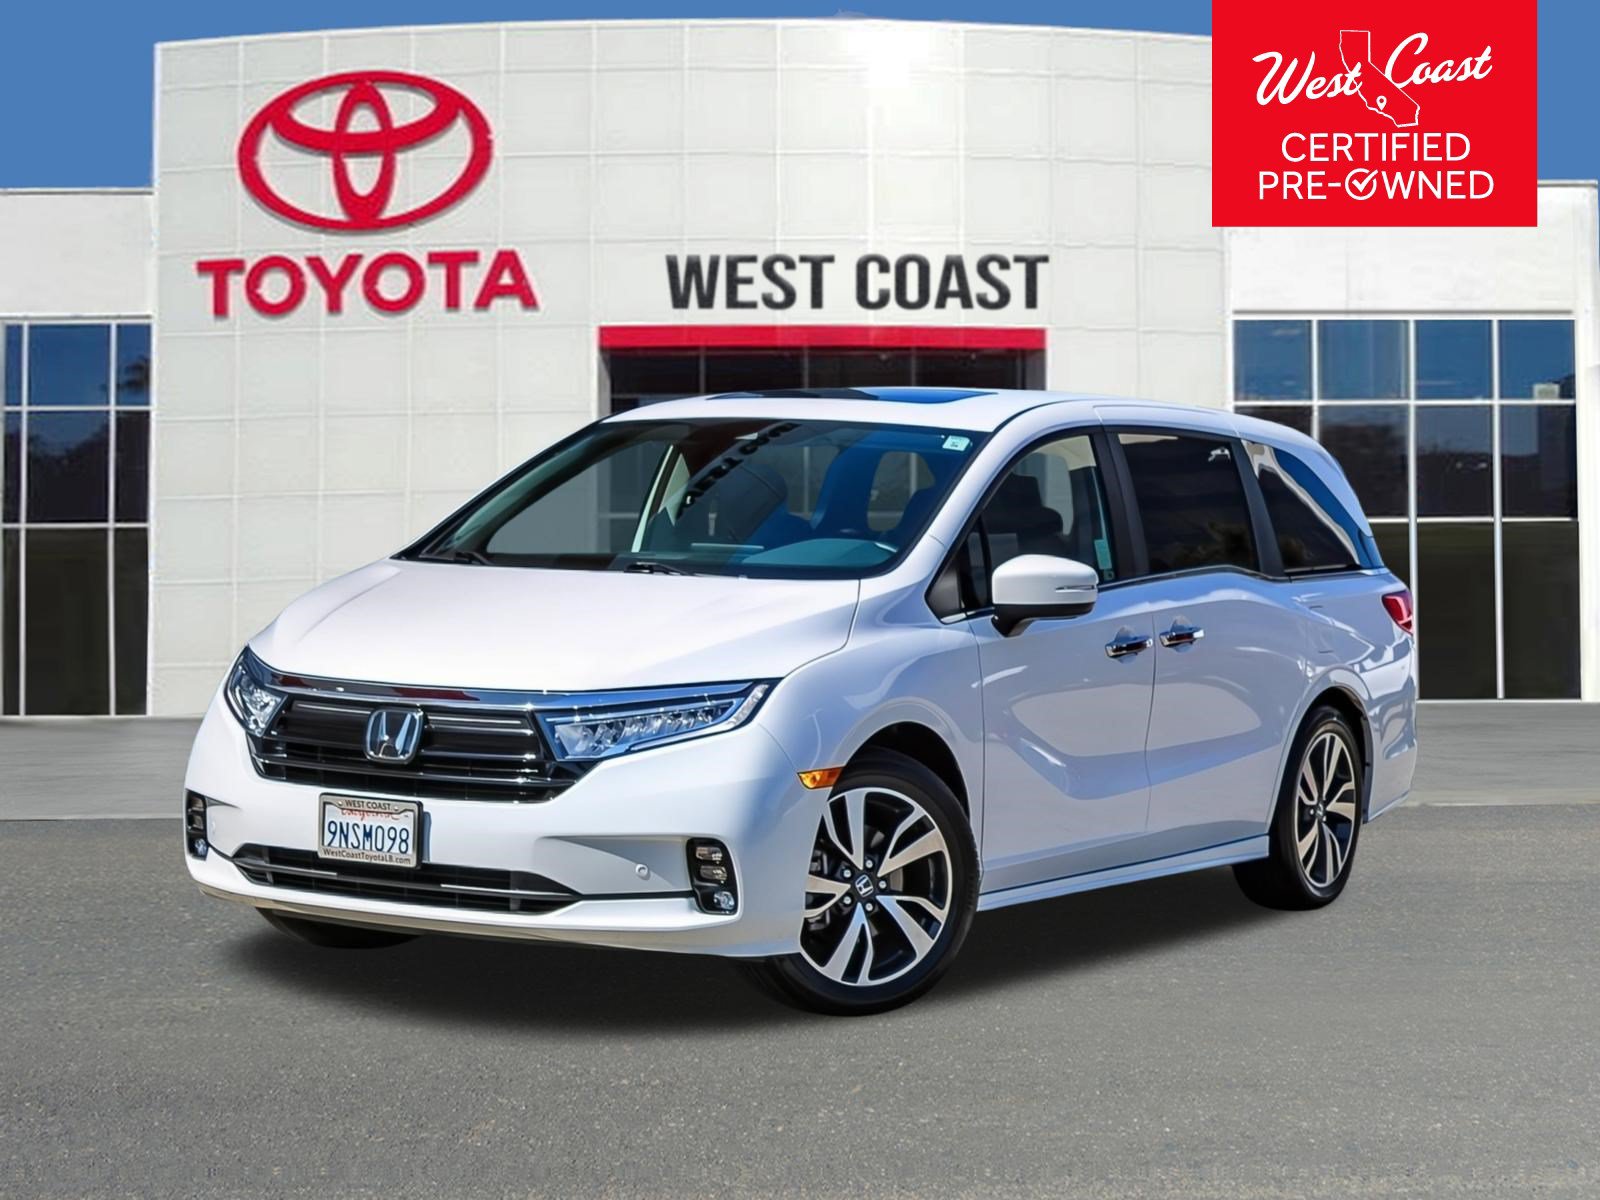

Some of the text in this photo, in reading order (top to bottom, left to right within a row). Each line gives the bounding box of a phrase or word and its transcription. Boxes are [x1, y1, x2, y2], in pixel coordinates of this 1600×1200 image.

[195, 249, 539, 318] TOYOTA
[666, 254, 1049, 310] WEST COAST
[344, 799, 391, 811] WEST COAST
[327, 820, 410, 855] 9NSM098
[322, 848, 411, 865] WestCoastToyotaLB.com
